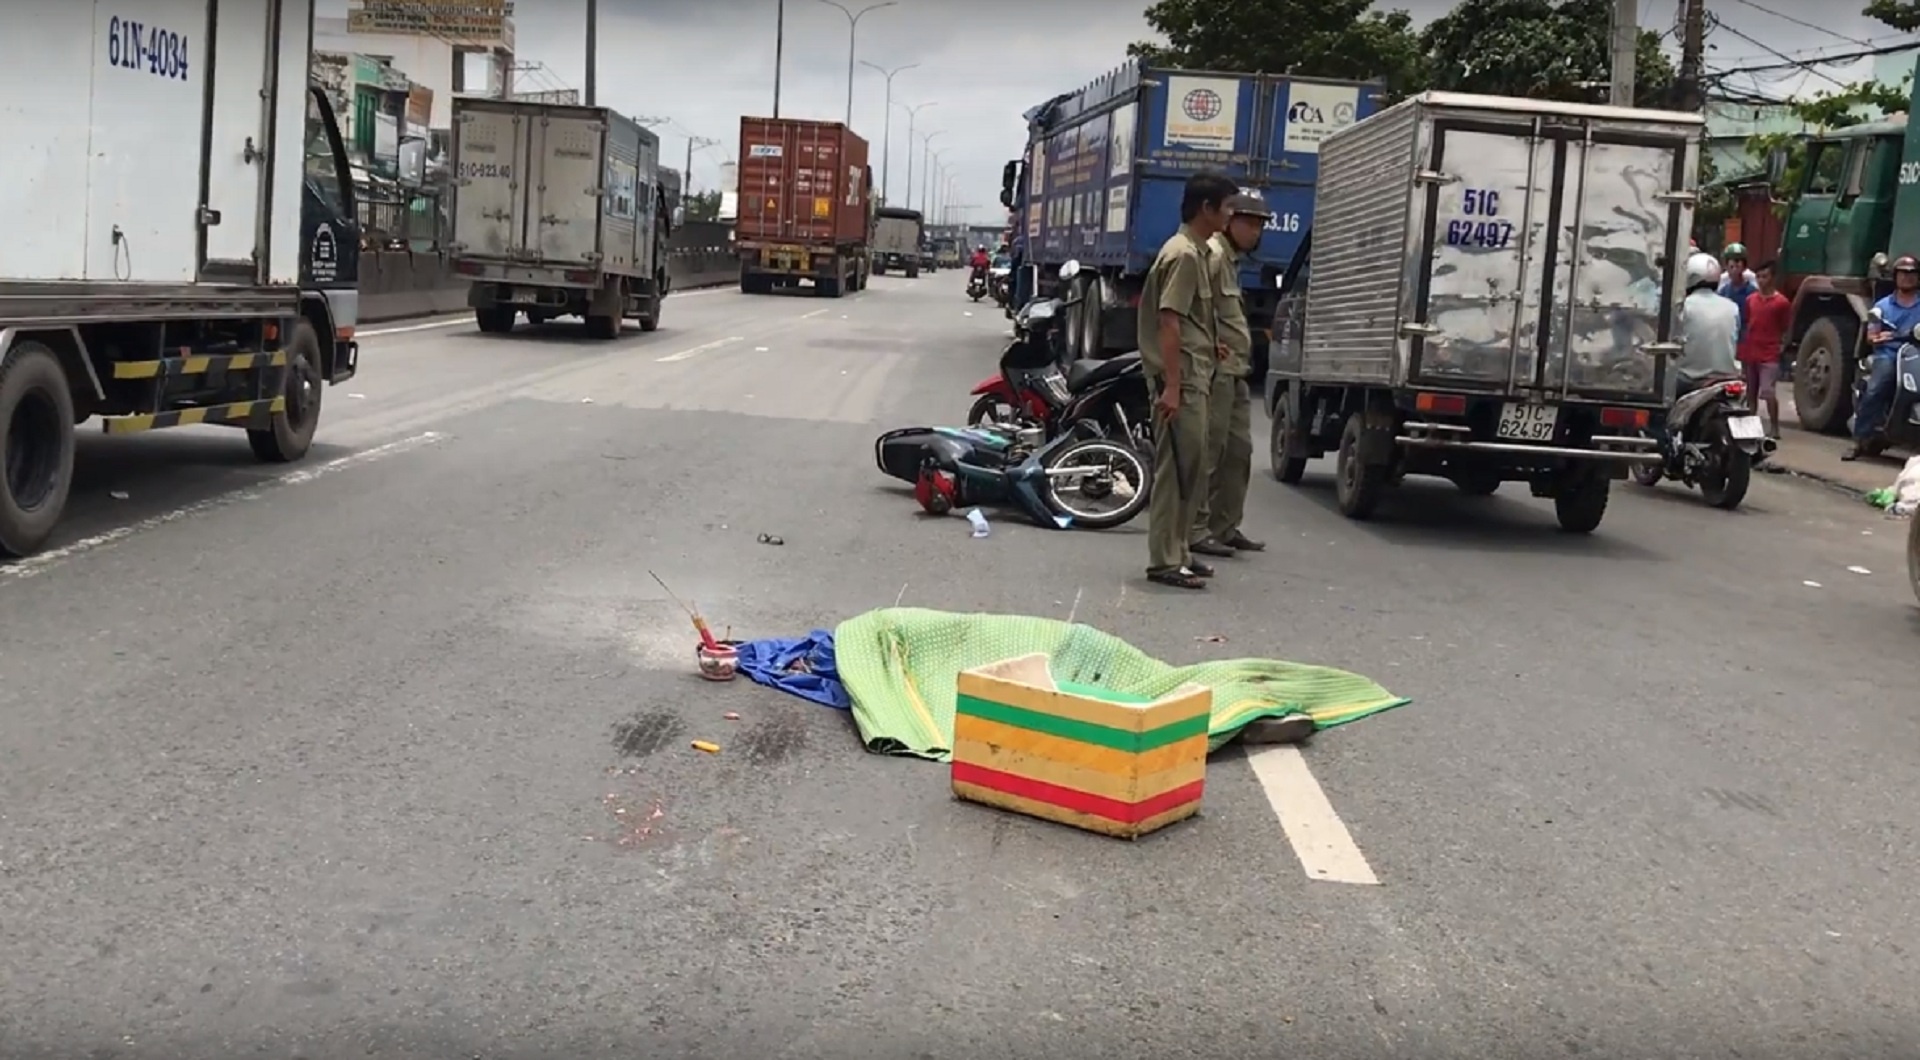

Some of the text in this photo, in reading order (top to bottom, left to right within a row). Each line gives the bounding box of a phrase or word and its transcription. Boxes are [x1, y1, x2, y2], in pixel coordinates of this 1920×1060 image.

[109, 15, 188, 81] 61N-4034
[1463, 188, 1500, 216] 51C
[1447, 220, 1512, 248] 62497
[1515, 404, 1545, 421] 51C
